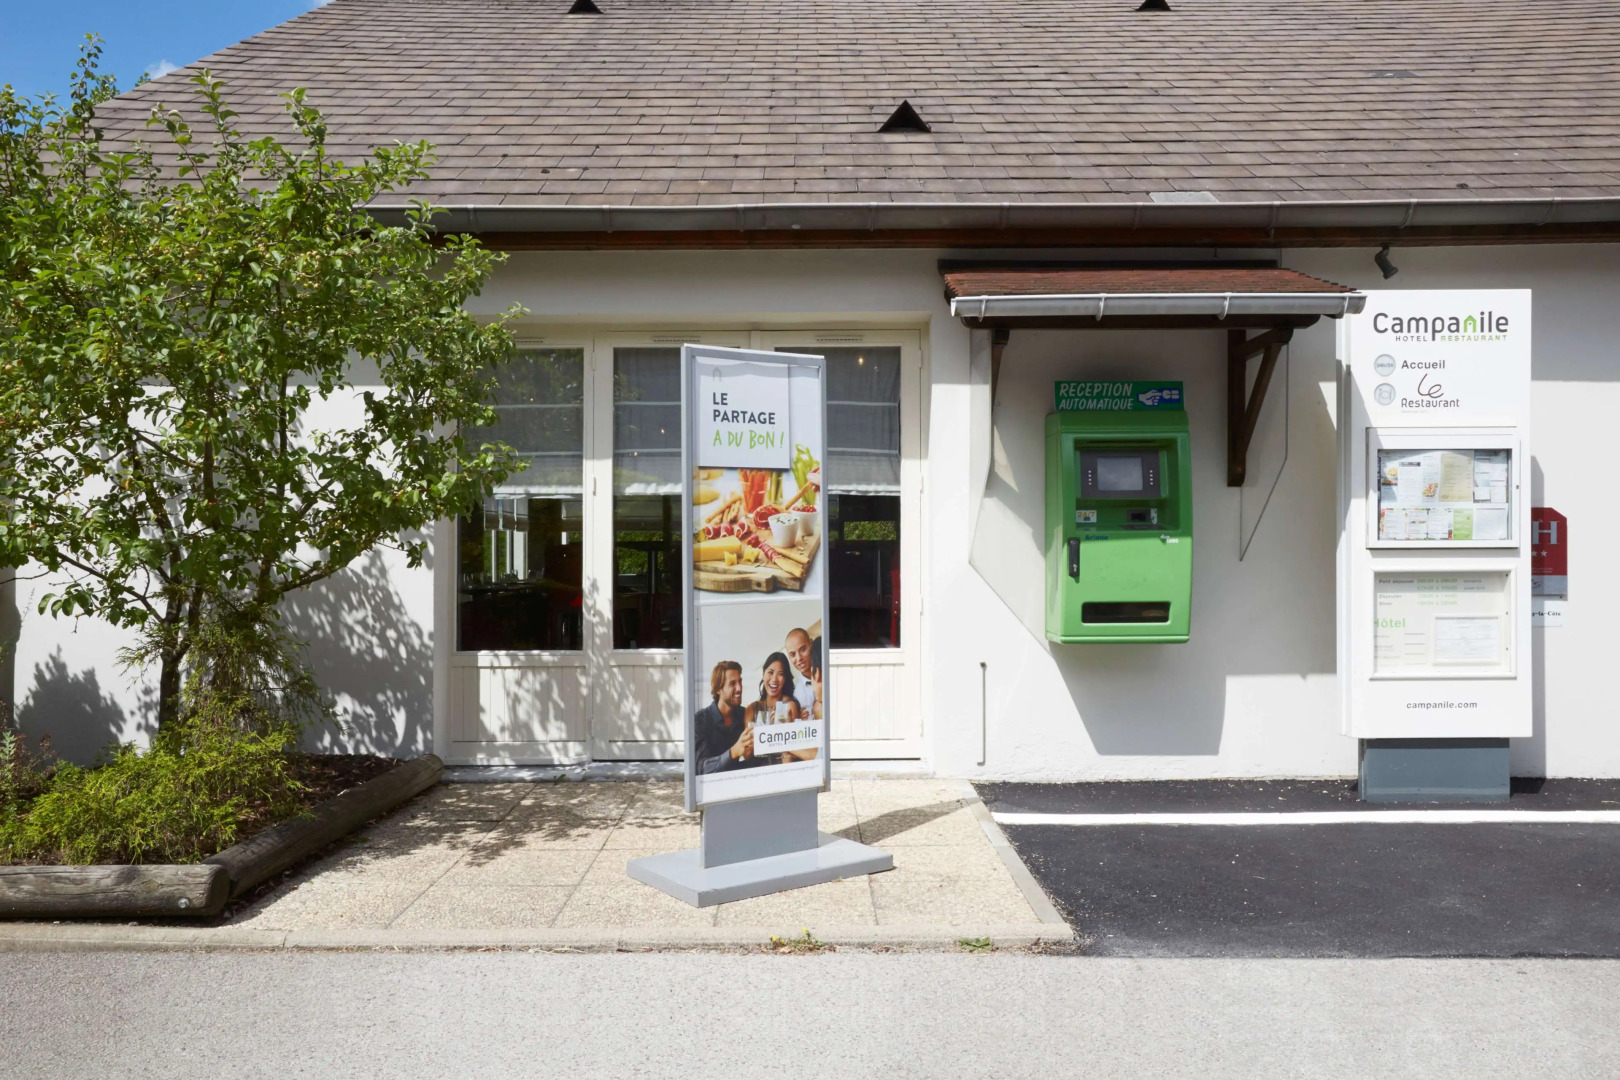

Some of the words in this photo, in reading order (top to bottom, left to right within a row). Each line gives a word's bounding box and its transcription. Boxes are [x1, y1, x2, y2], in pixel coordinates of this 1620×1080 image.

[1373, 311, 1509, 342] Campanile
[1440, 334, 1508, 342] RESTAURANT
[1401, 360, 1446, 370] Accueil
[1059, 383, 1133, 397] RECEPTION
[1417, 373, 1444, 399] Le
[713, 392, 728, 406] LE
[1059, 398, 1134, 410] AUTOMATIQUE
[1401, 398, 1460, 408] Restaurant
[713, 409, 776, 425] PARTAGE
[728, 431, 743, 447] DU
[1531, 520, 1560, 545] H
[1406, 700, 1478, 710] campanile.com
[759, 726, 818, 746] Campanile
